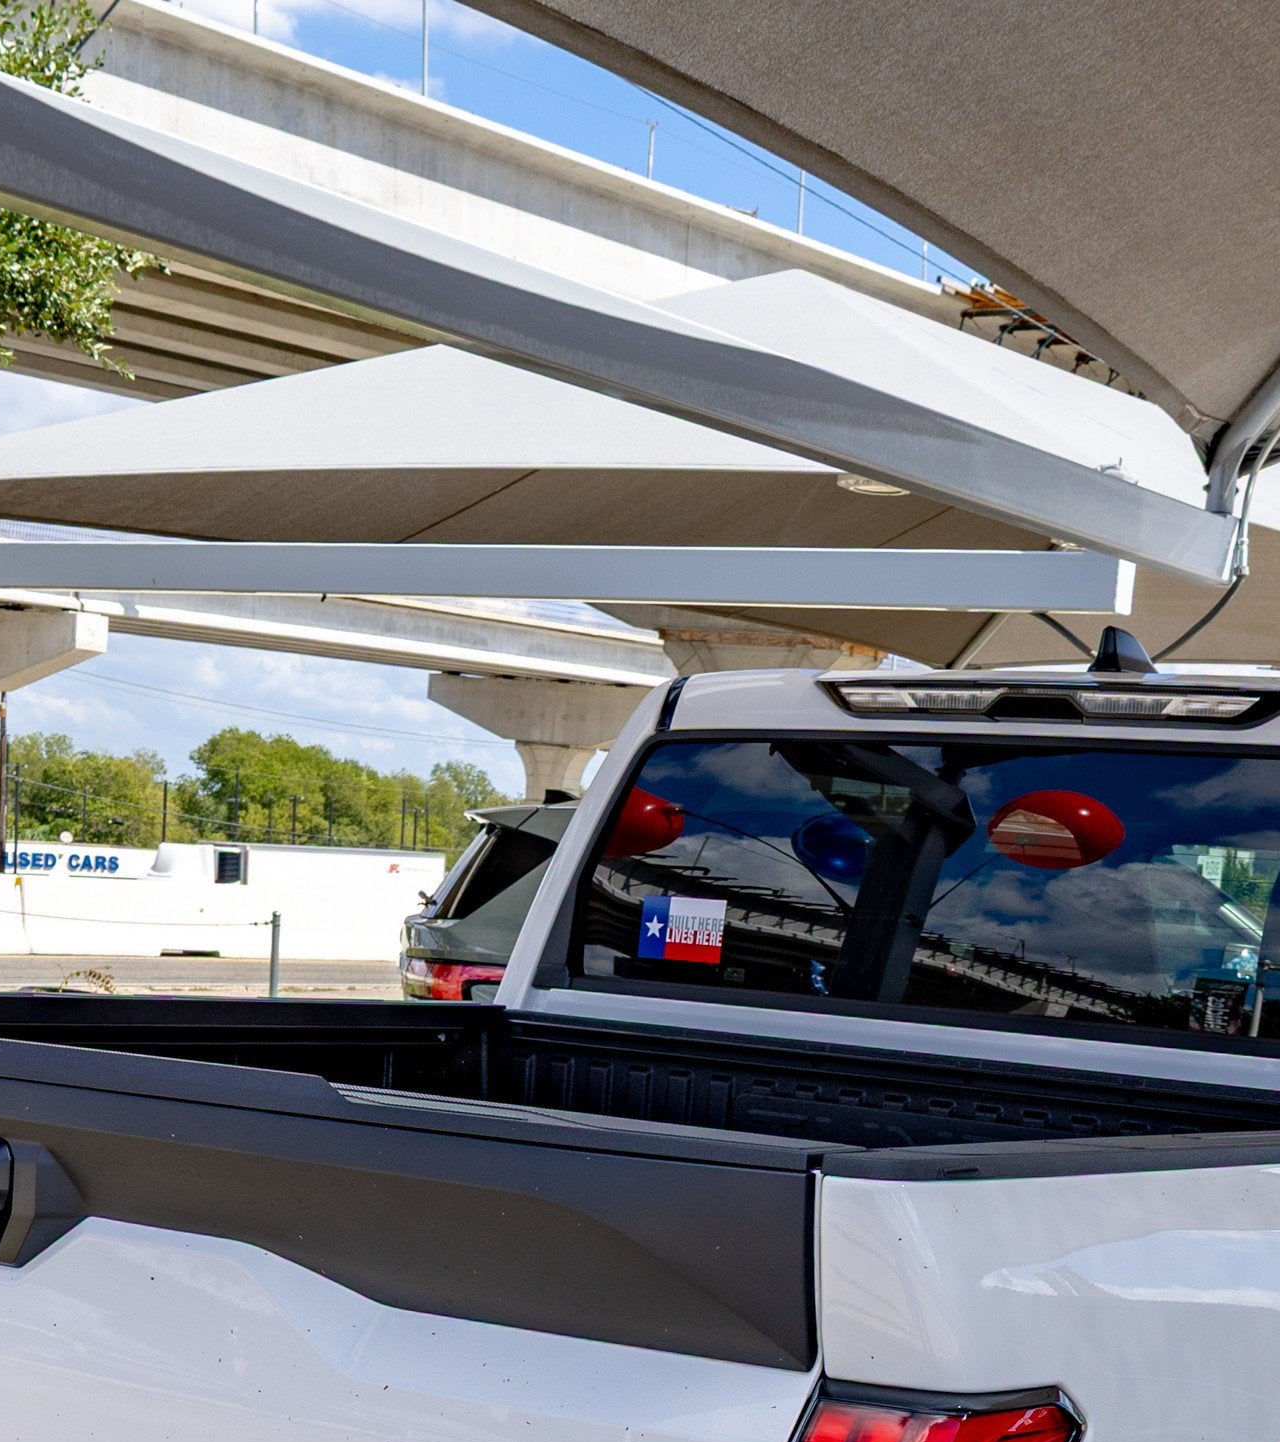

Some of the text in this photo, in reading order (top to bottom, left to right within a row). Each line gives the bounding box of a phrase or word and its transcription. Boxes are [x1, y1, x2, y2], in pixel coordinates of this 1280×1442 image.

[5, 852, 119, 872] USED CARS
[669, 915, 723, 932] BUILT HERE
[666, 928, 722, 946] LIVES HERE
